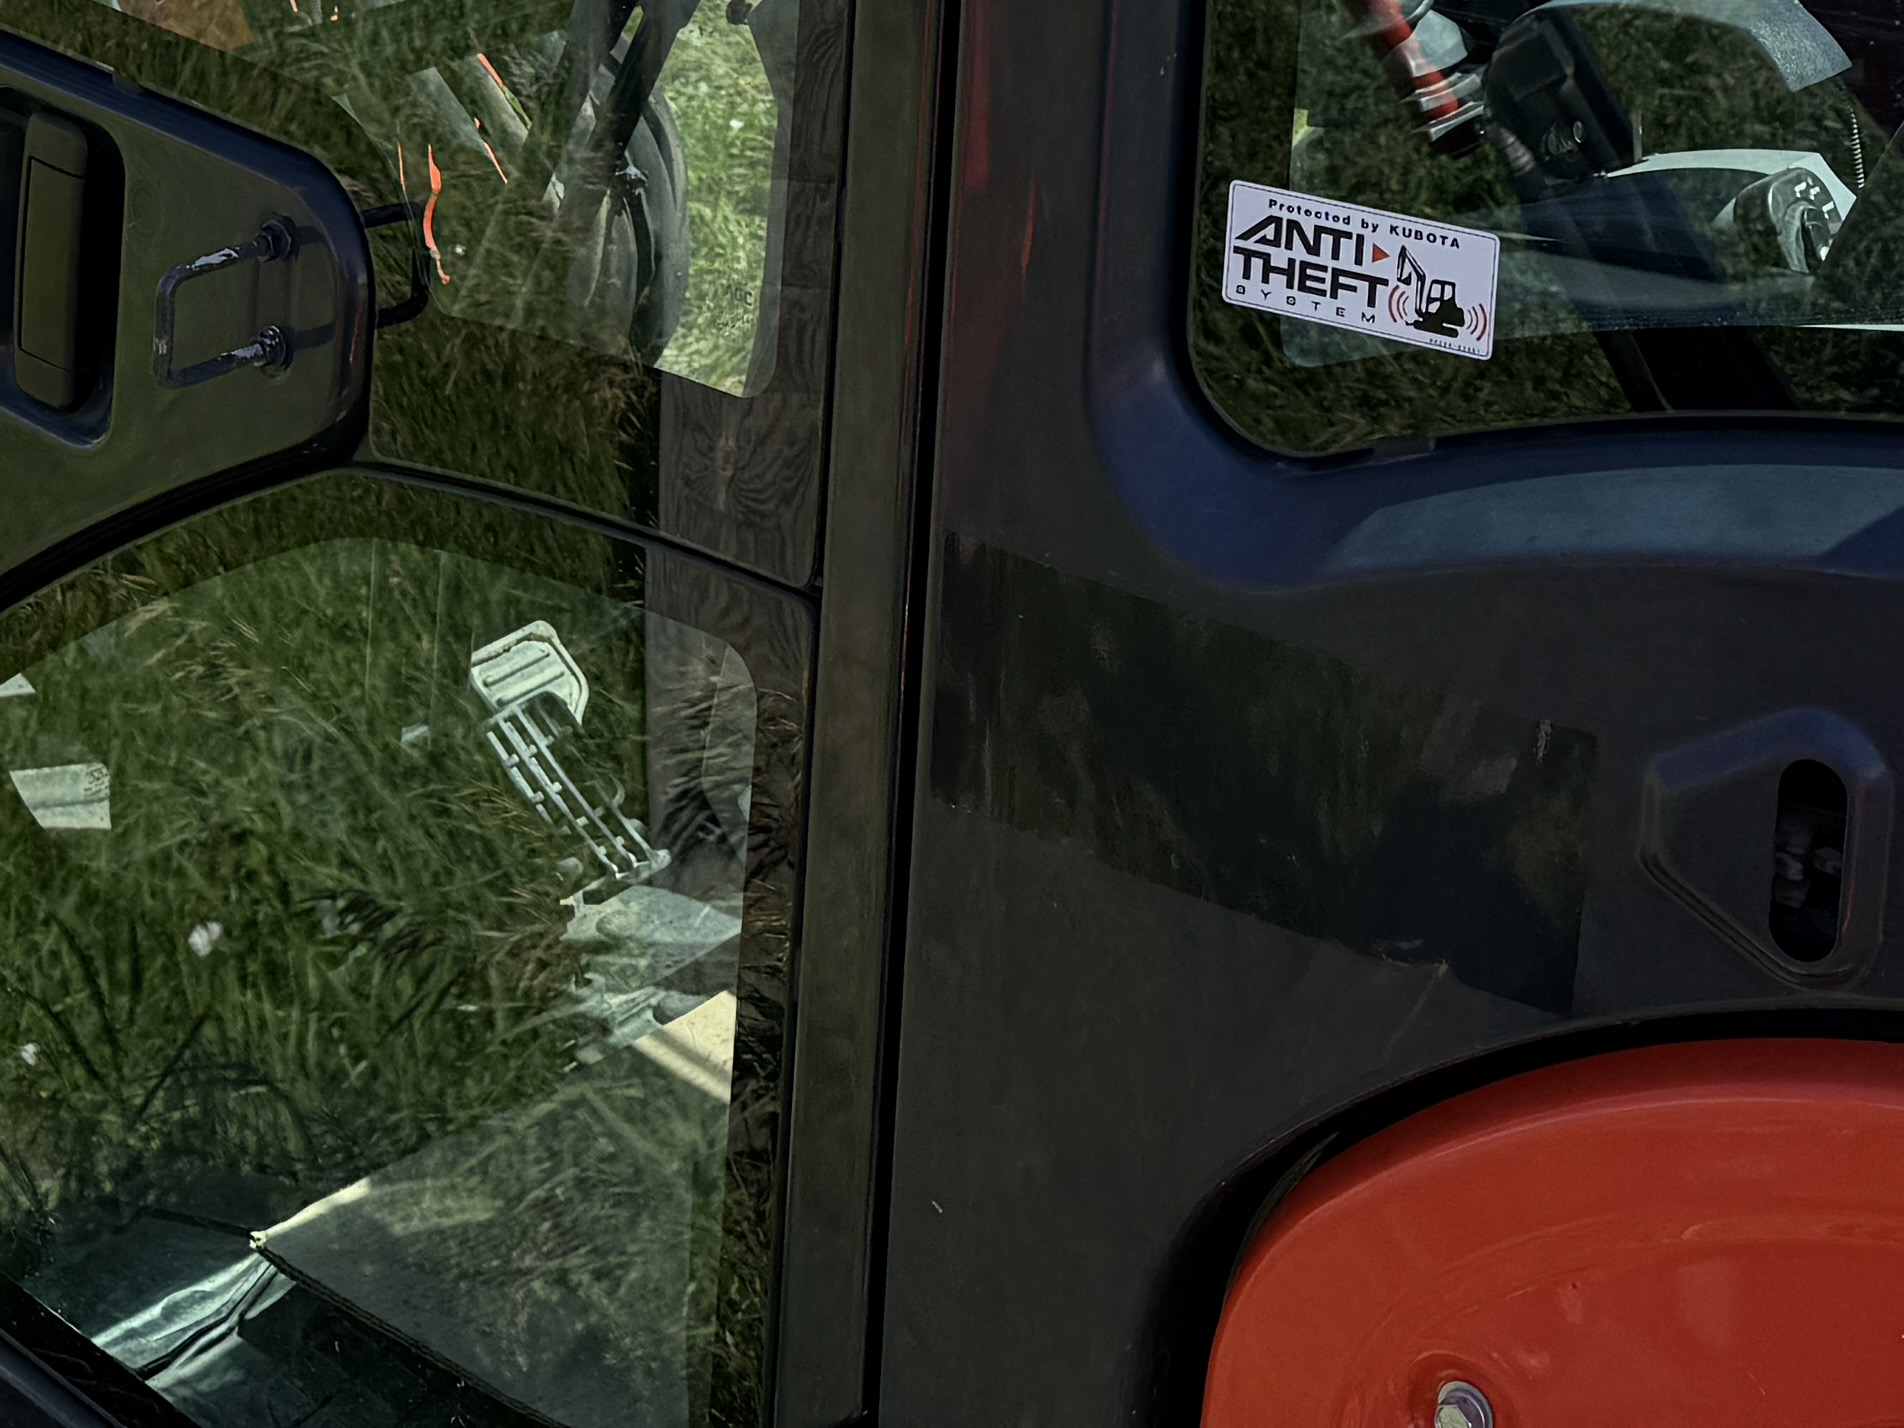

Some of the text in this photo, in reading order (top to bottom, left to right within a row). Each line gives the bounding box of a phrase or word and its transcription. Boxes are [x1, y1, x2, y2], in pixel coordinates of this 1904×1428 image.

[1235, 214, 1364, 266] ANTI
[1268, 199, 1461, 249] Protected by KUBOTA
[1232, 245, 1390, 309] THEFT
[1235, 284, 1377, 324] SYSTEM
